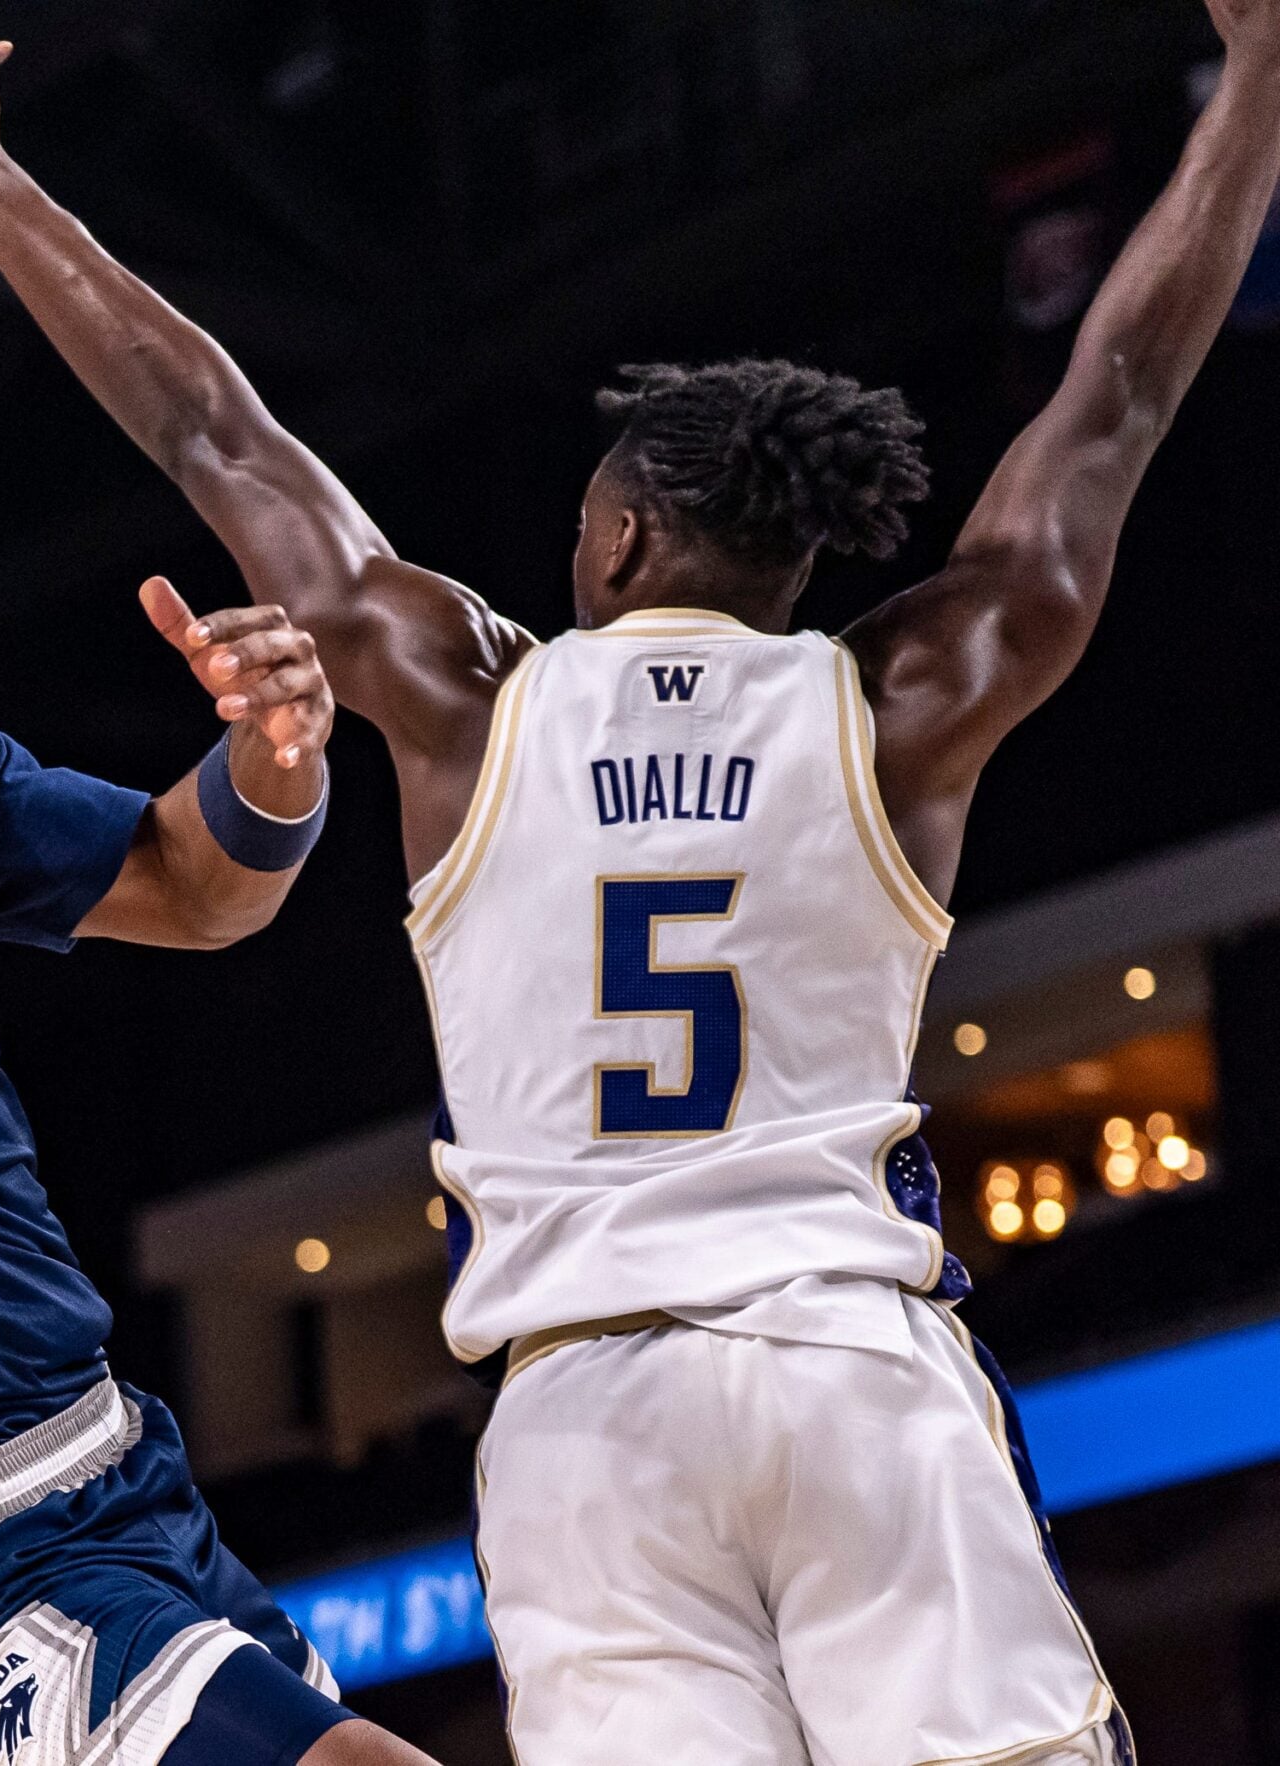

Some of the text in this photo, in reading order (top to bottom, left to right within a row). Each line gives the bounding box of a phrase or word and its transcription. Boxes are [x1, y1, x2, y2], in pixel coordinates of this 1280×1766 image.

[646, 665, 706, 702] W
[591, 753, 756, 826] DIALLO
[593, 870, 749, 1140] 5
